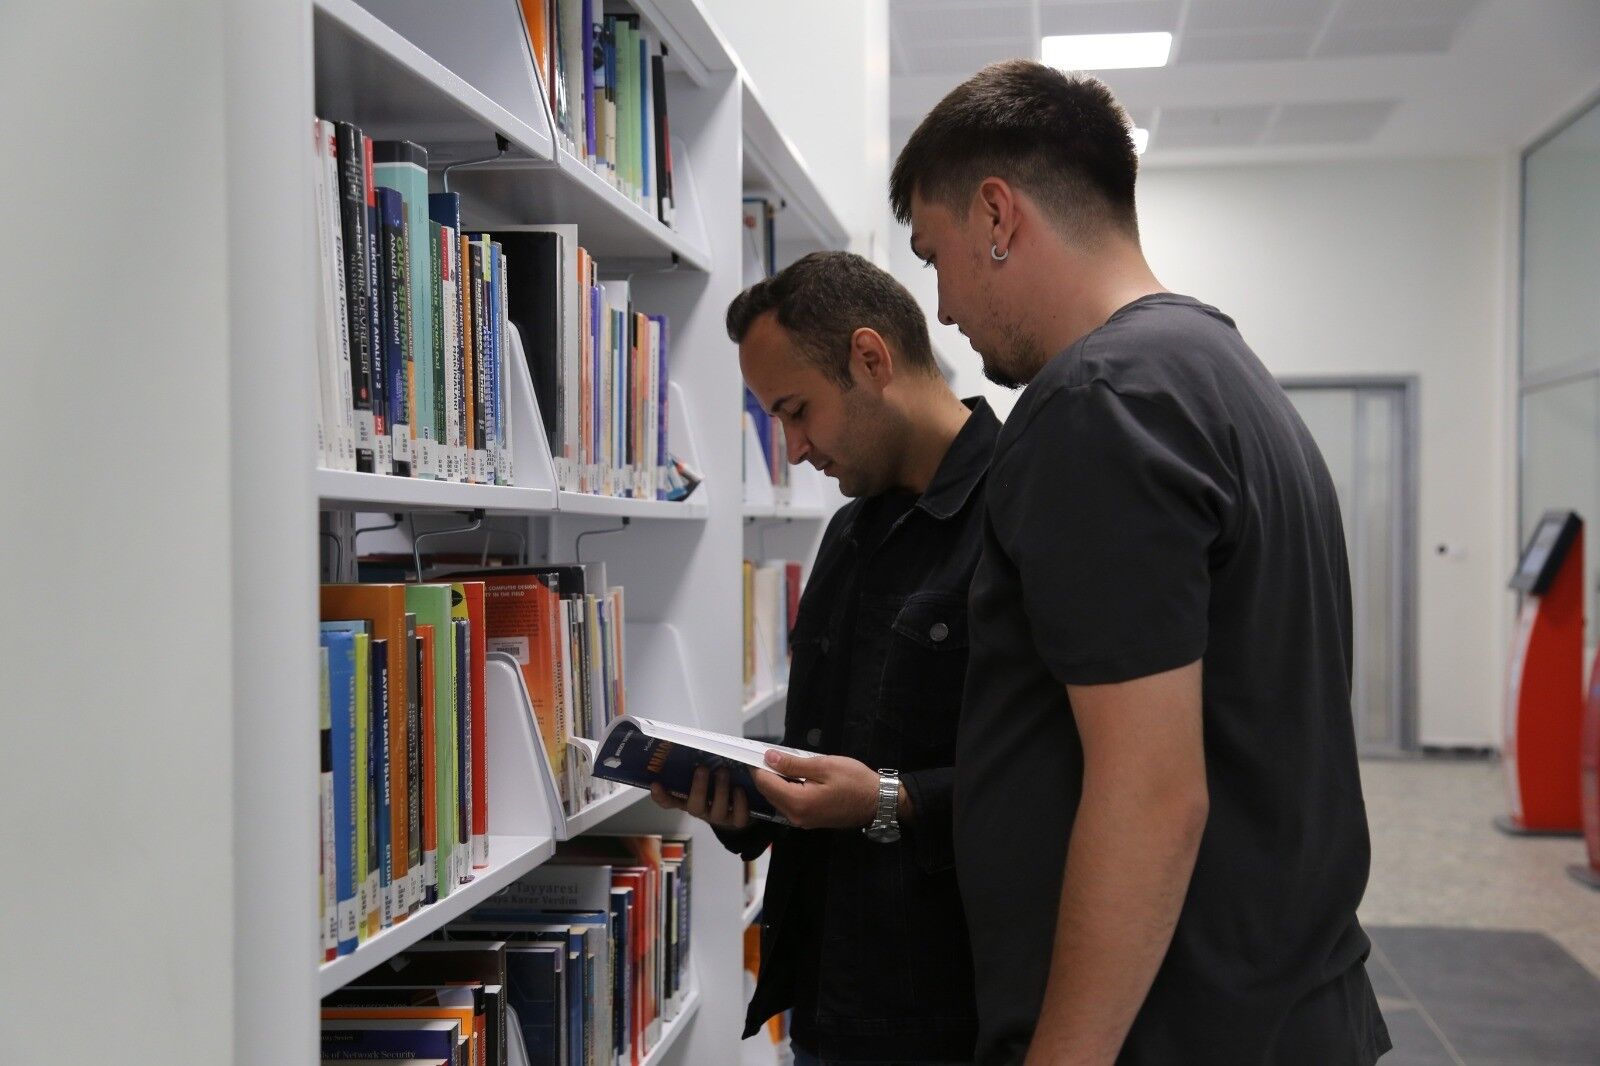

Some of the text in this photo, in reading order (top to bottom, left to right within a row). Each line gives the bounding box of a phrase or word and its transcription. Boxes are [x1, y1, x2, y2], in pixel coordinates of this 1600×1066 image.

[336, 236, 344, 292] Elektrik
[370, 233, 378, 286] ELEKTRİK
[390, 232, 398, 280] ANALİZİ
[396, 236, 405, 277] GÜÇ
[392, 290, 400, 345] TASARIMI
[373, 326, 381, 371] ANALİZİ
[381, 1049, 416, 1060] Security
